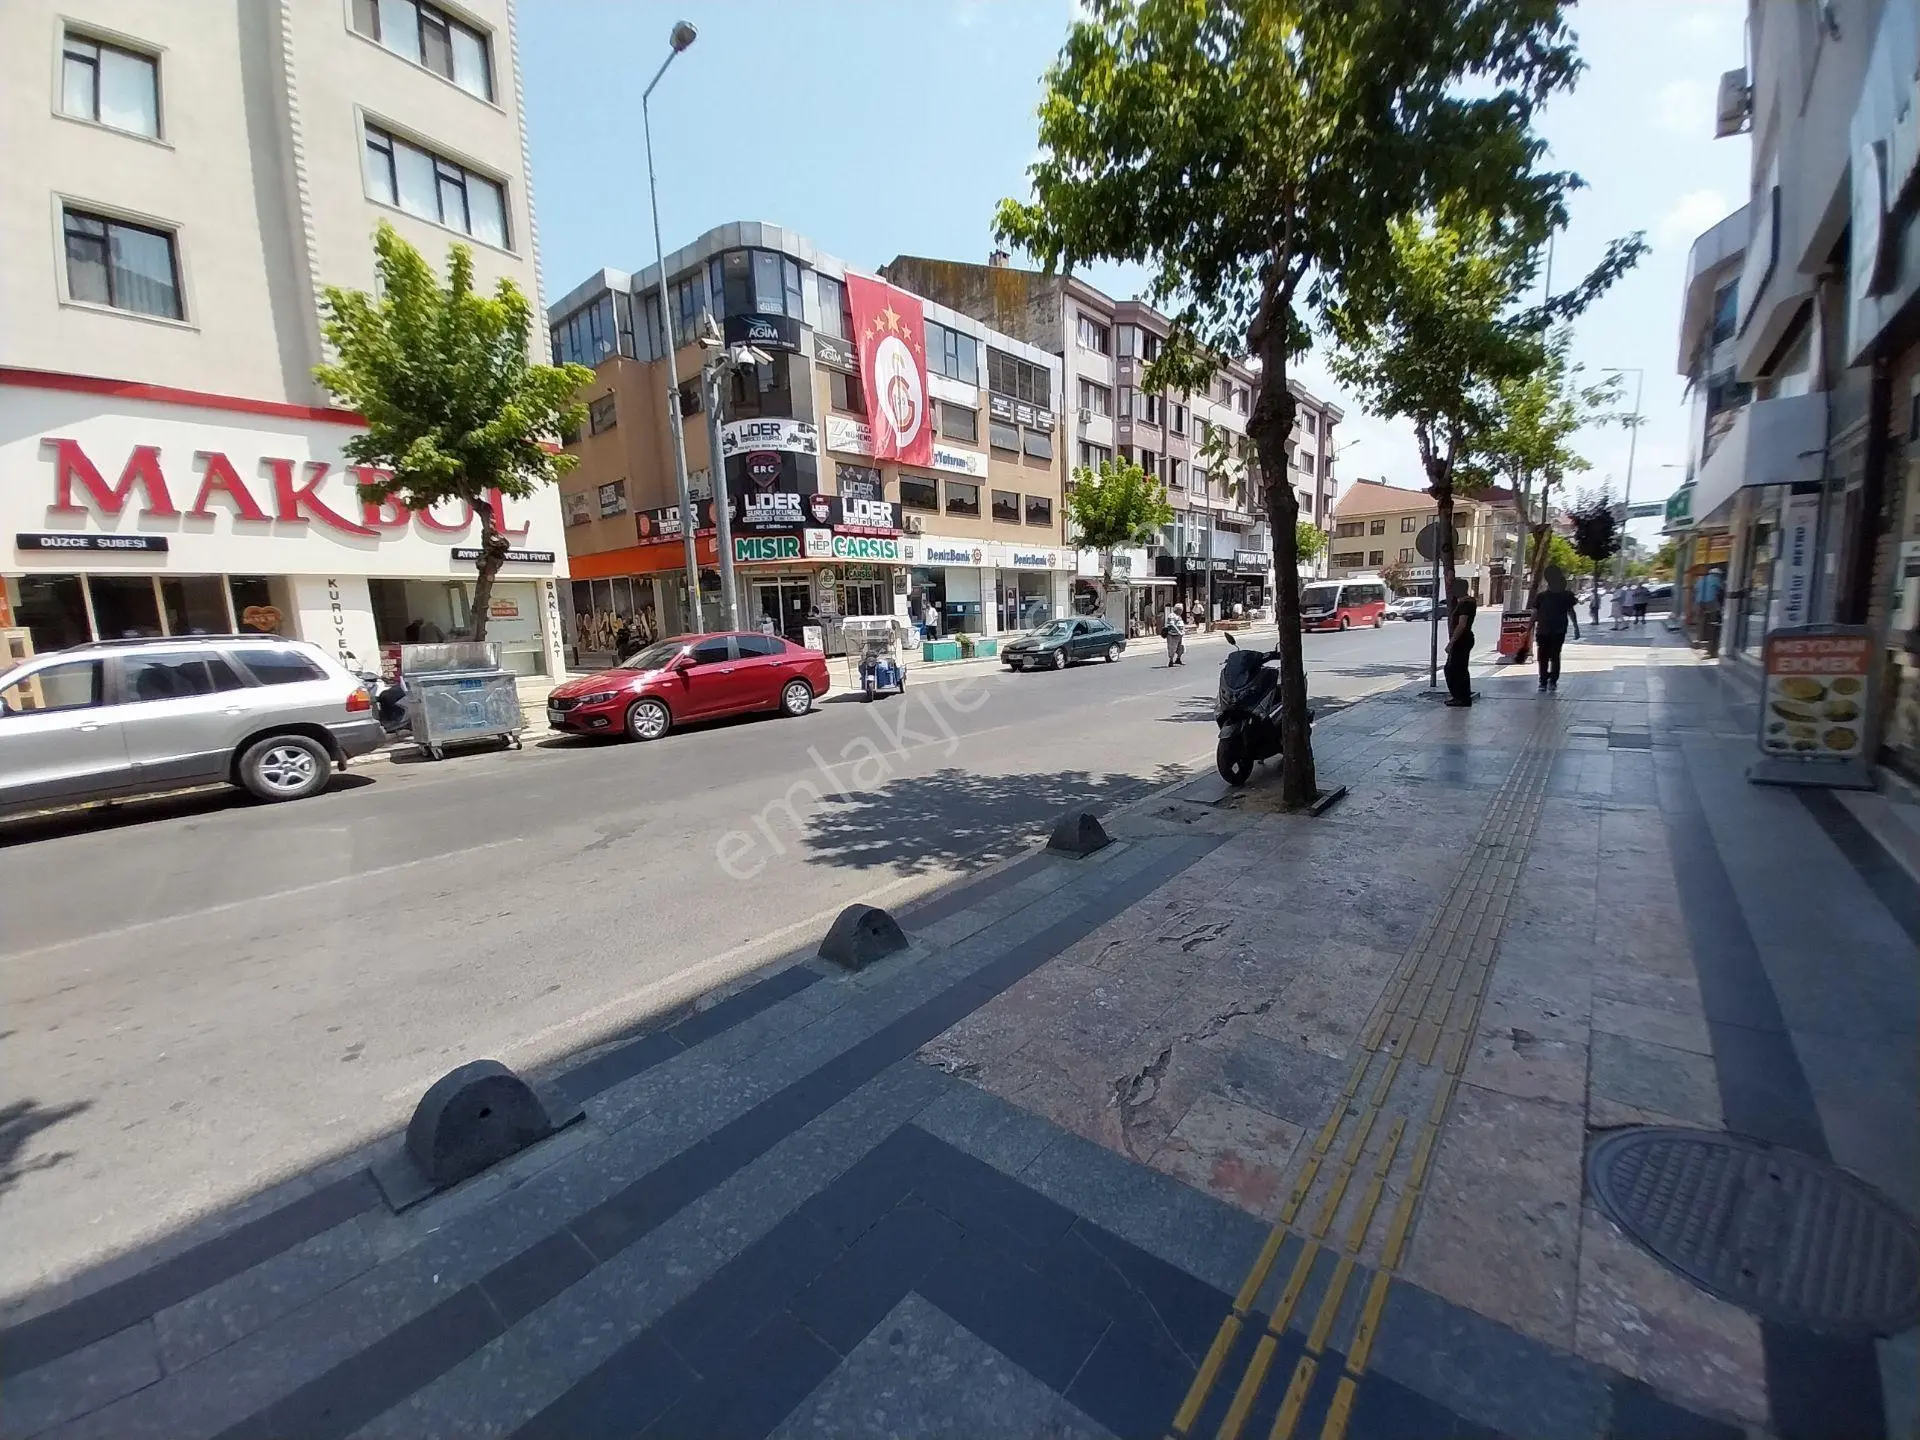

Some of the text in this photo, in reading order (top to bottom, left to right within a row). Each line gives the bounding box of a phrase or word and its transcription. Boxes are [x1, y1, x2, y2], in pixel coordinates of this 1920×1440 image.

[753, 465, 775, 473] ERC
[40, 536, 89, 548] DÜZCE
[736, 536, 800, 561] MISIR
[808, 540, 830, 551] HEP
[927, 547, 970, 562] DenizBank
[1775, 656, 1861, 672] EKMEK
